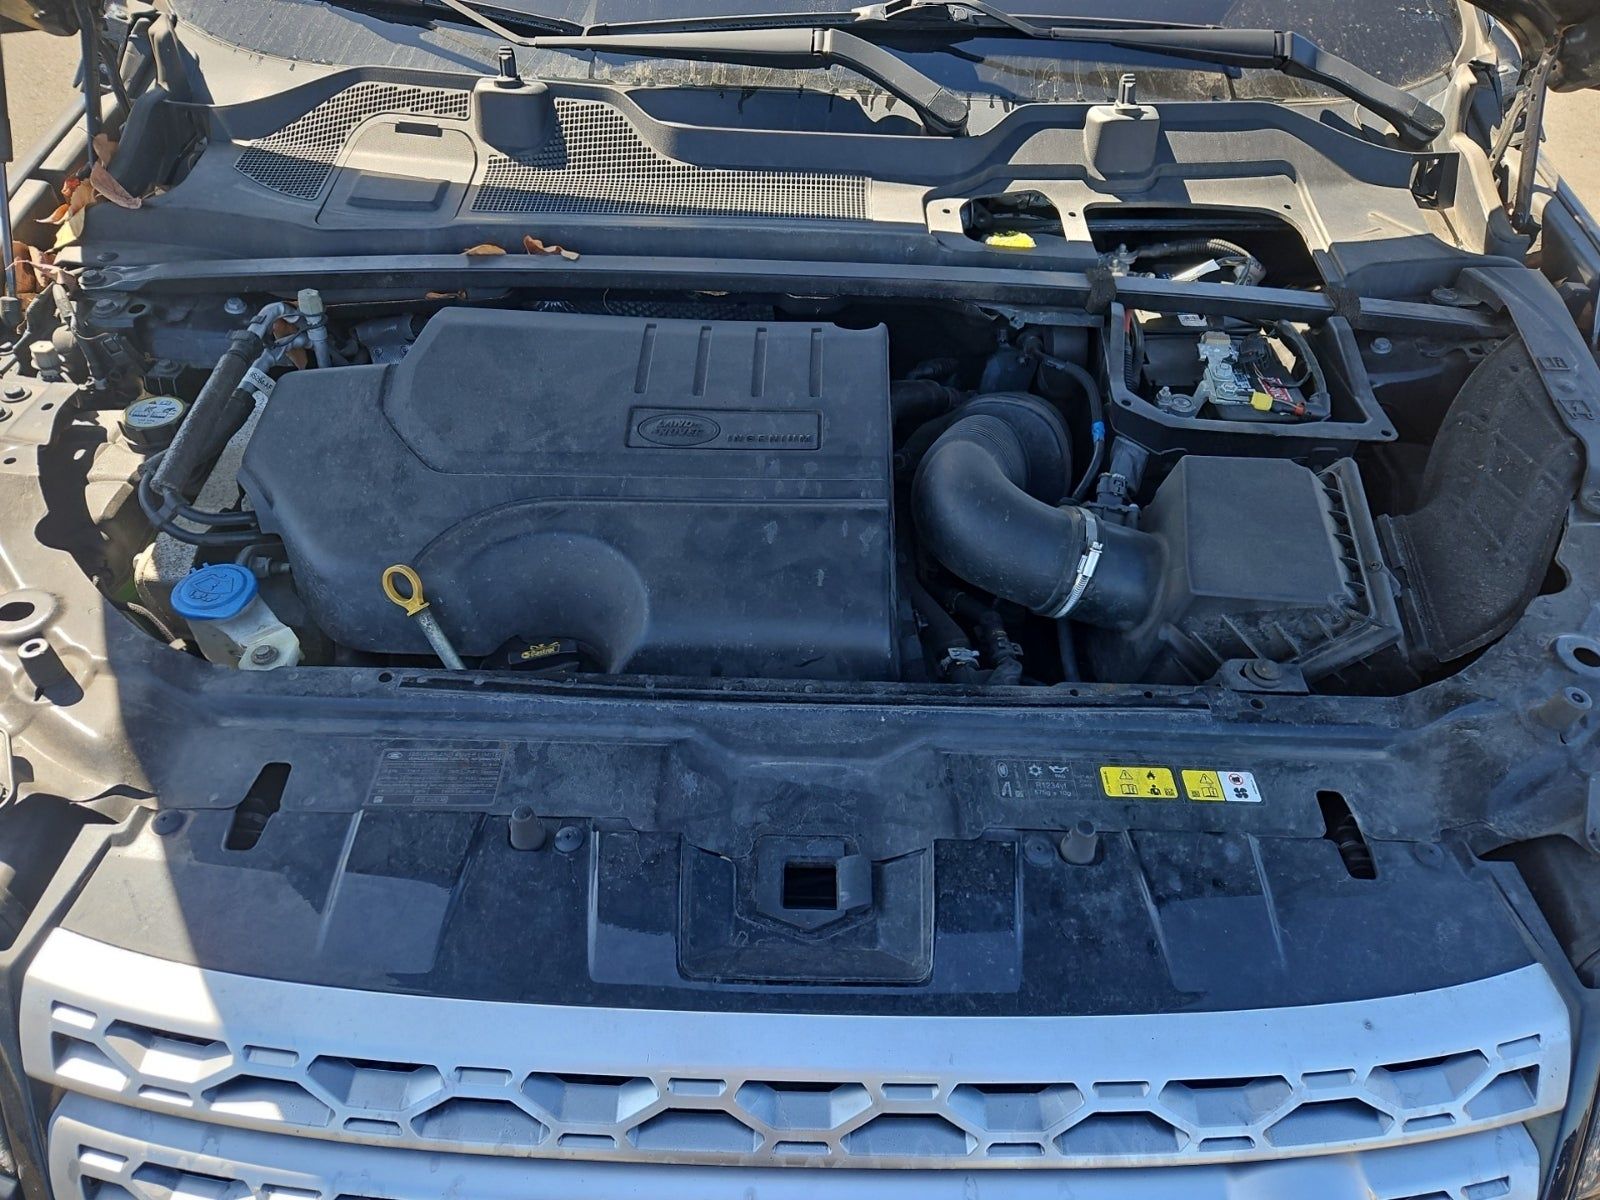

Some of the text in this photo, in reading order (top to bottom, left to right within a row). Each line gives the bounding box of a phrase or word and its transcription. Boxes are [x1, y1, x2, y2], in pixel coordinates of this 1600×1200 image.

[657, 418, 693, 428] LAND
[657, 427, 704, 437] ROVER
[727, 433, 812, 444] INGENIUM
